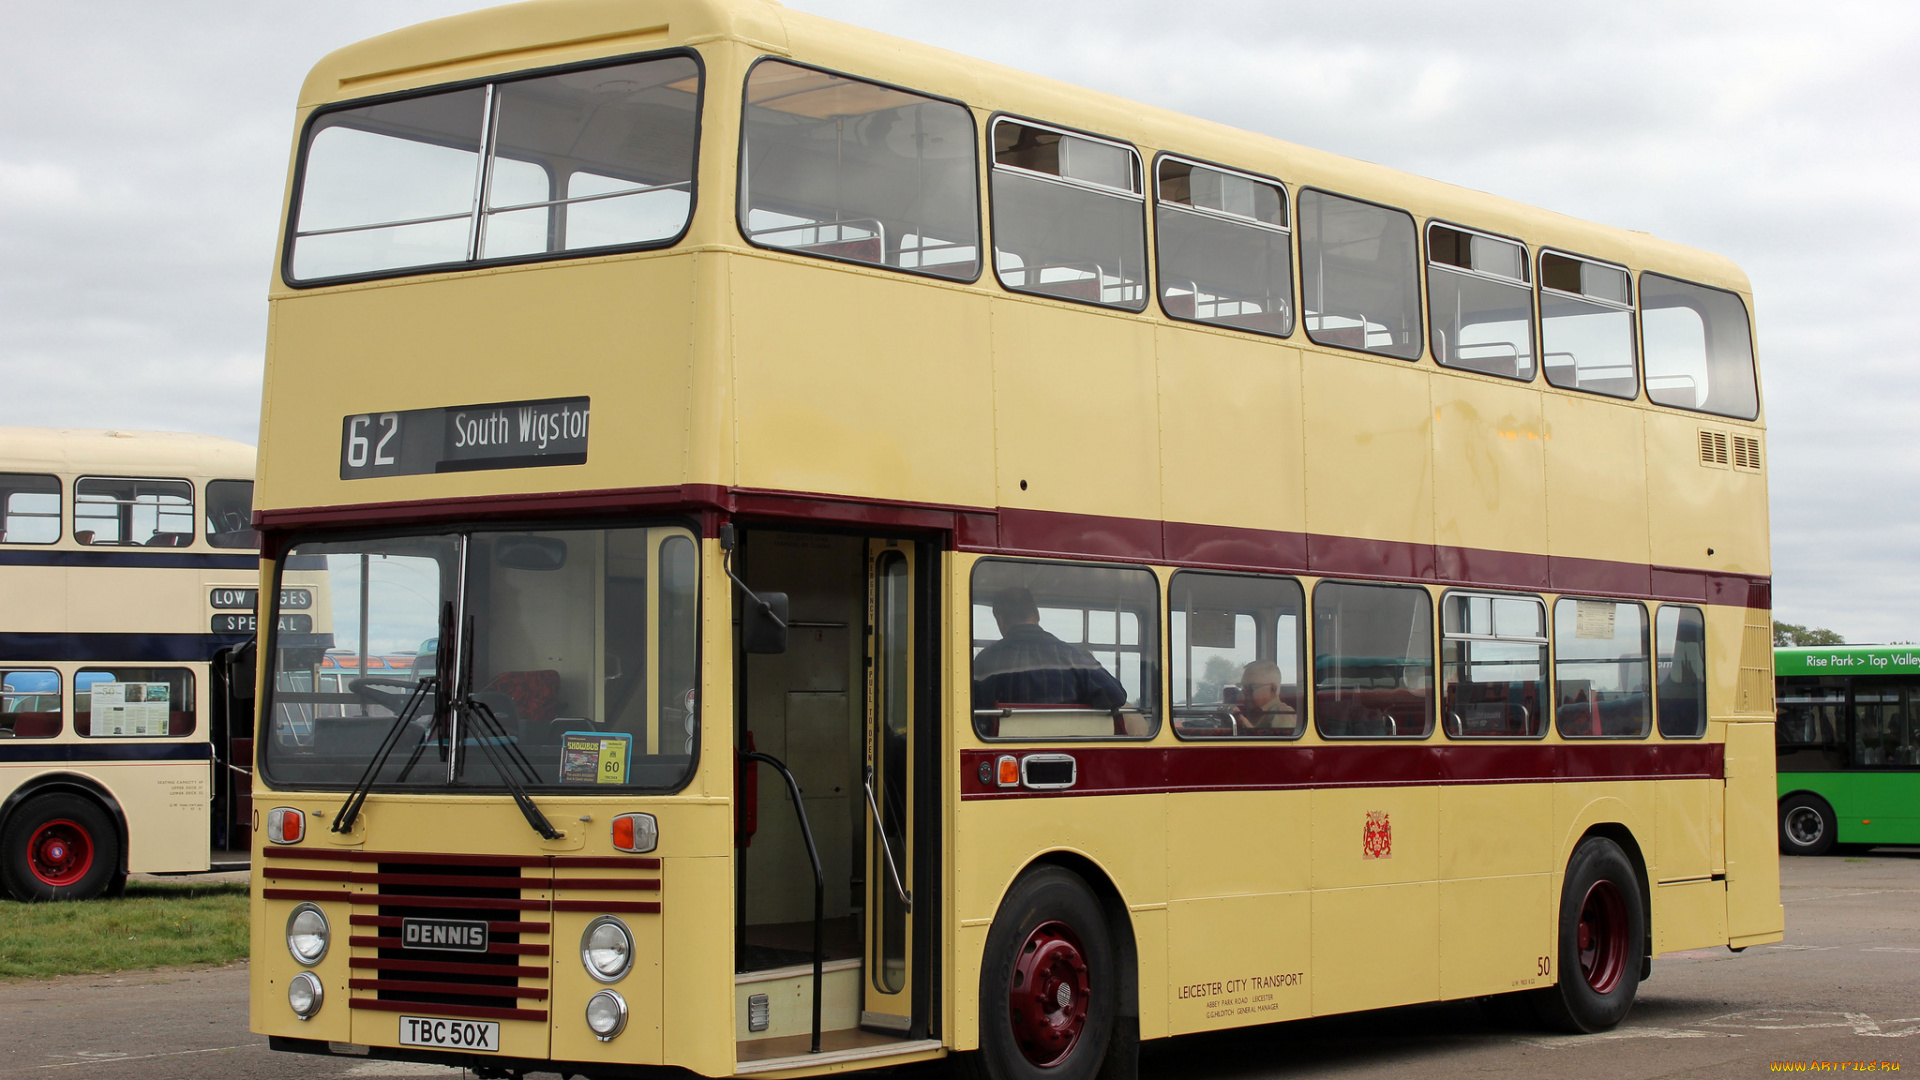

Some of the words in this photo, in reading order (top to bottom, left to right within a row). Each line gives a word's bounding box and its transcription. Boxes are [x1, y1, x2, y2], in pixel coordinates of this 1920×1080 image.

[455, 409, 509, 448] South
[347, 412, 398, 468] 62
[215, 590, 246, 605] LOW
[227, 616, 297, 631] SPEAL
[1806, 655, 1828, 667] Rise
[1830, 654, 1854, 666] Park
[1867, 654, 1888, 669] Top
[868, 708, 873, 725] TO
[605, 761, 620, 772] 60
[406, 924, 483, 946] DENNIS
[1537, 955, 1550, 976] 50
[1178, 981, 1223, 999] LEICESTER
[1226, 978, 1248, 993] CITY
[1251, 972, 1304, 990] TRANSPORT
[1206, 1000, 1221, 1008] ABBEY
[1252, 994, 1274, 1003] LEICESTER
[1237, 1006, 1256, 1015] GENERAL
[1257, 1003, 1279, 1012] MANAGER
